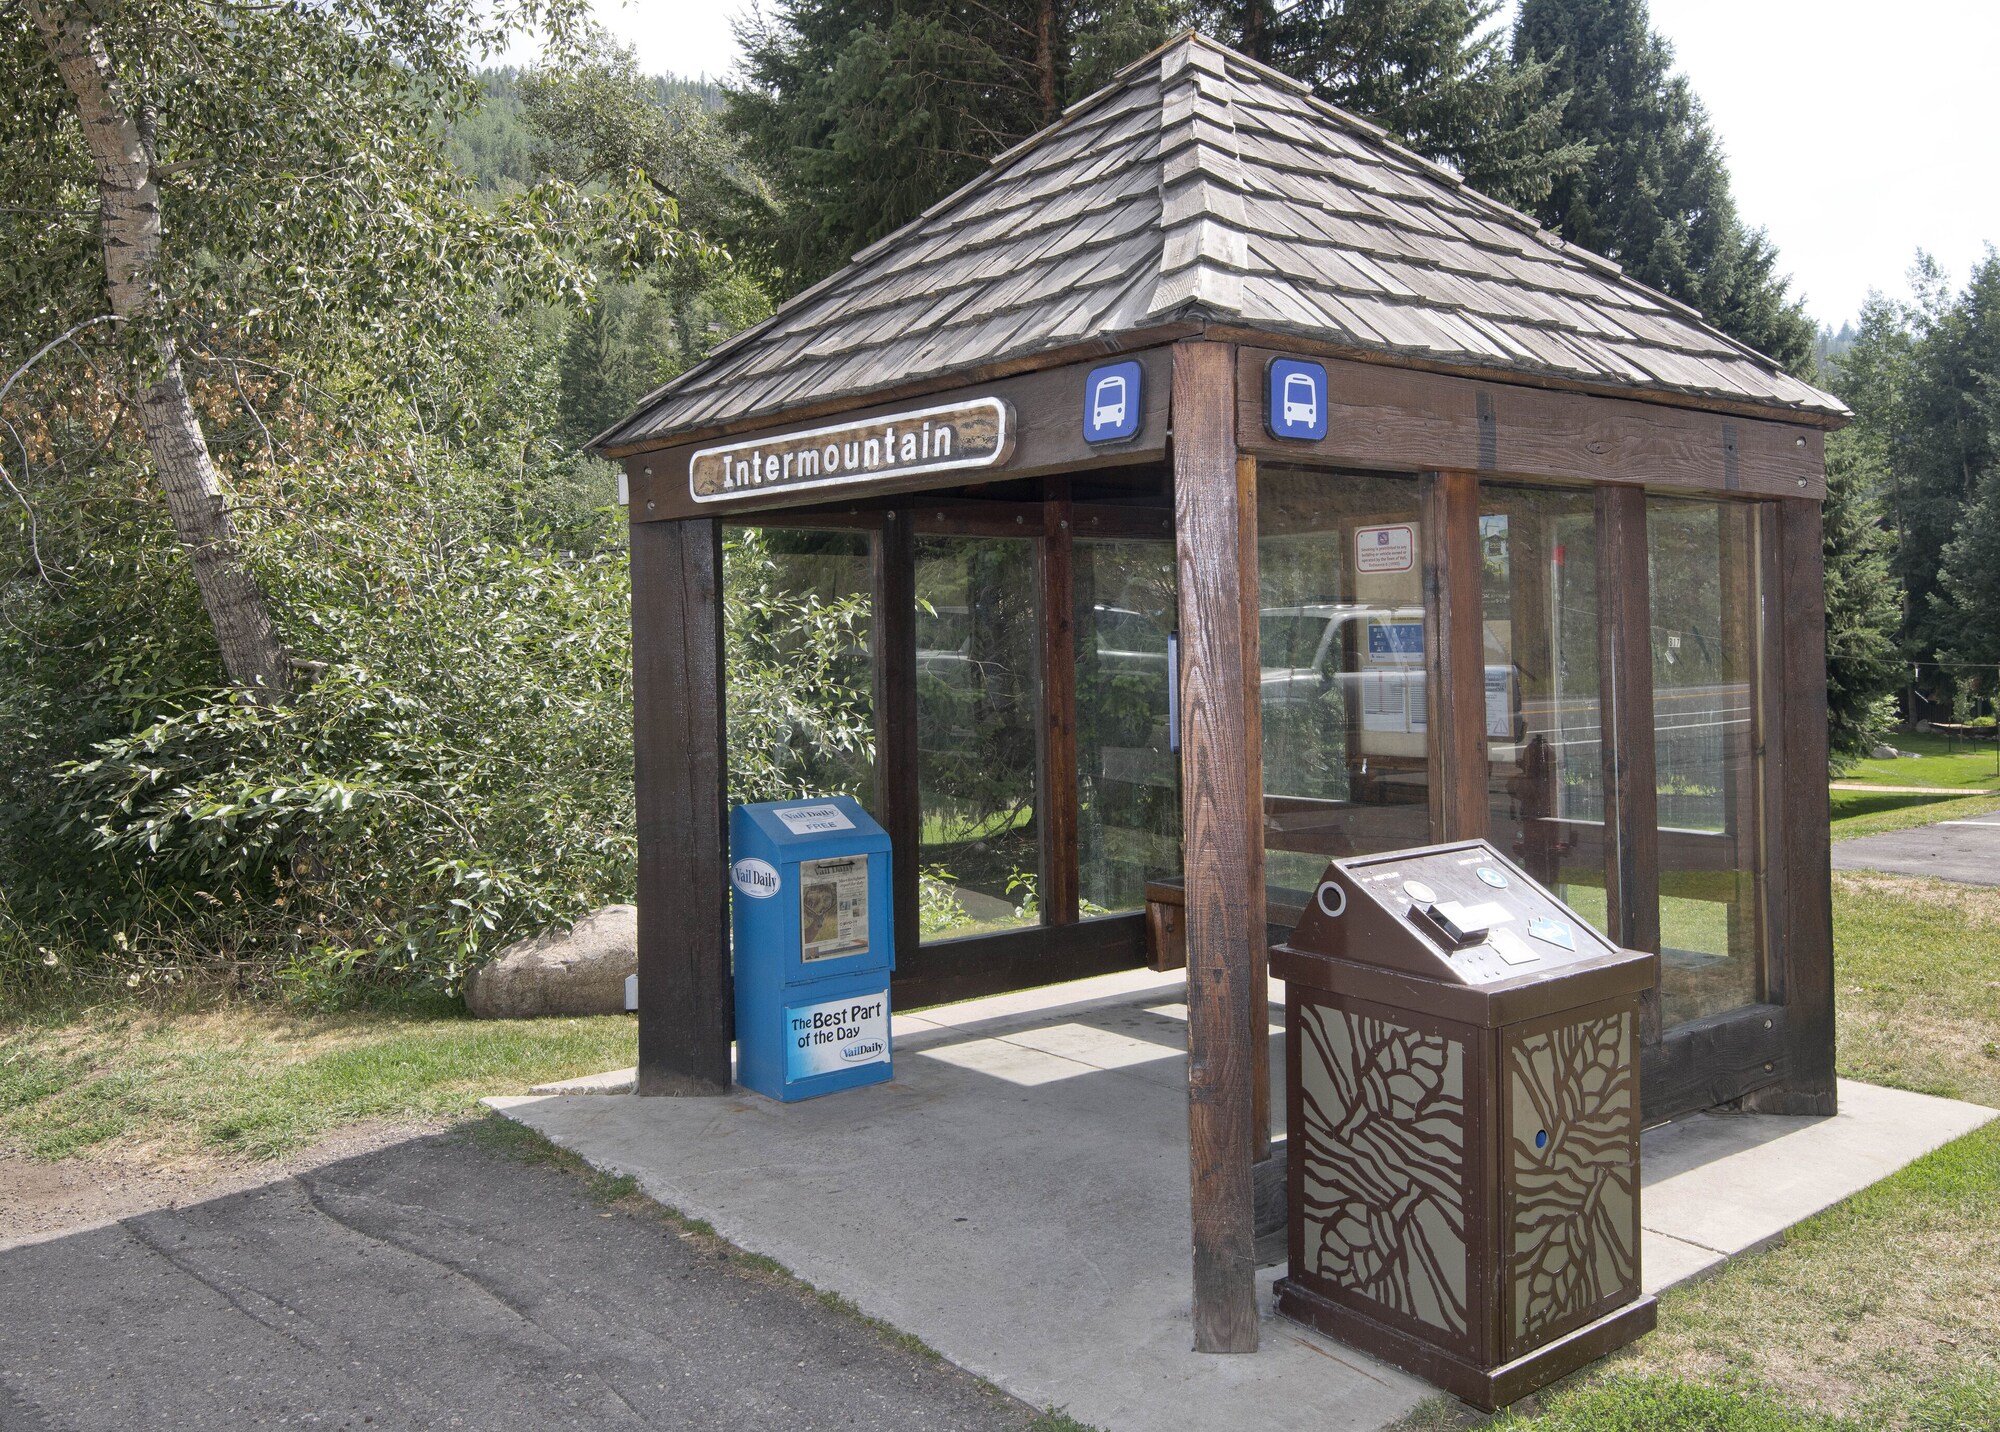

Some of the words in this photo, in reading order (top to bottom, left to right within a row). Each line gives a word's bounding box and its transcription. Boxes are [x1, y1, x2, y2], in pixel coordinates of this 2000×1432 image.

[723, 422, 952, 488] Intermountain
[785, 812, 806, 820] Vail
[806, 809, 834, 818] Daily
[806, 821, 837, 830] FREE
[735, 867, 751, 884] Vail
[753, 870, 776, 892] Daily
[792, 1018, 811, 1031] The
[813, 1008, 847, 1029] Best
[851, 1002, 881, 1022] Part
[798, 1034, 811, 1048] of
[813, 1030, 834, 1046] the
[837, 1026, 860, 1041] Day
